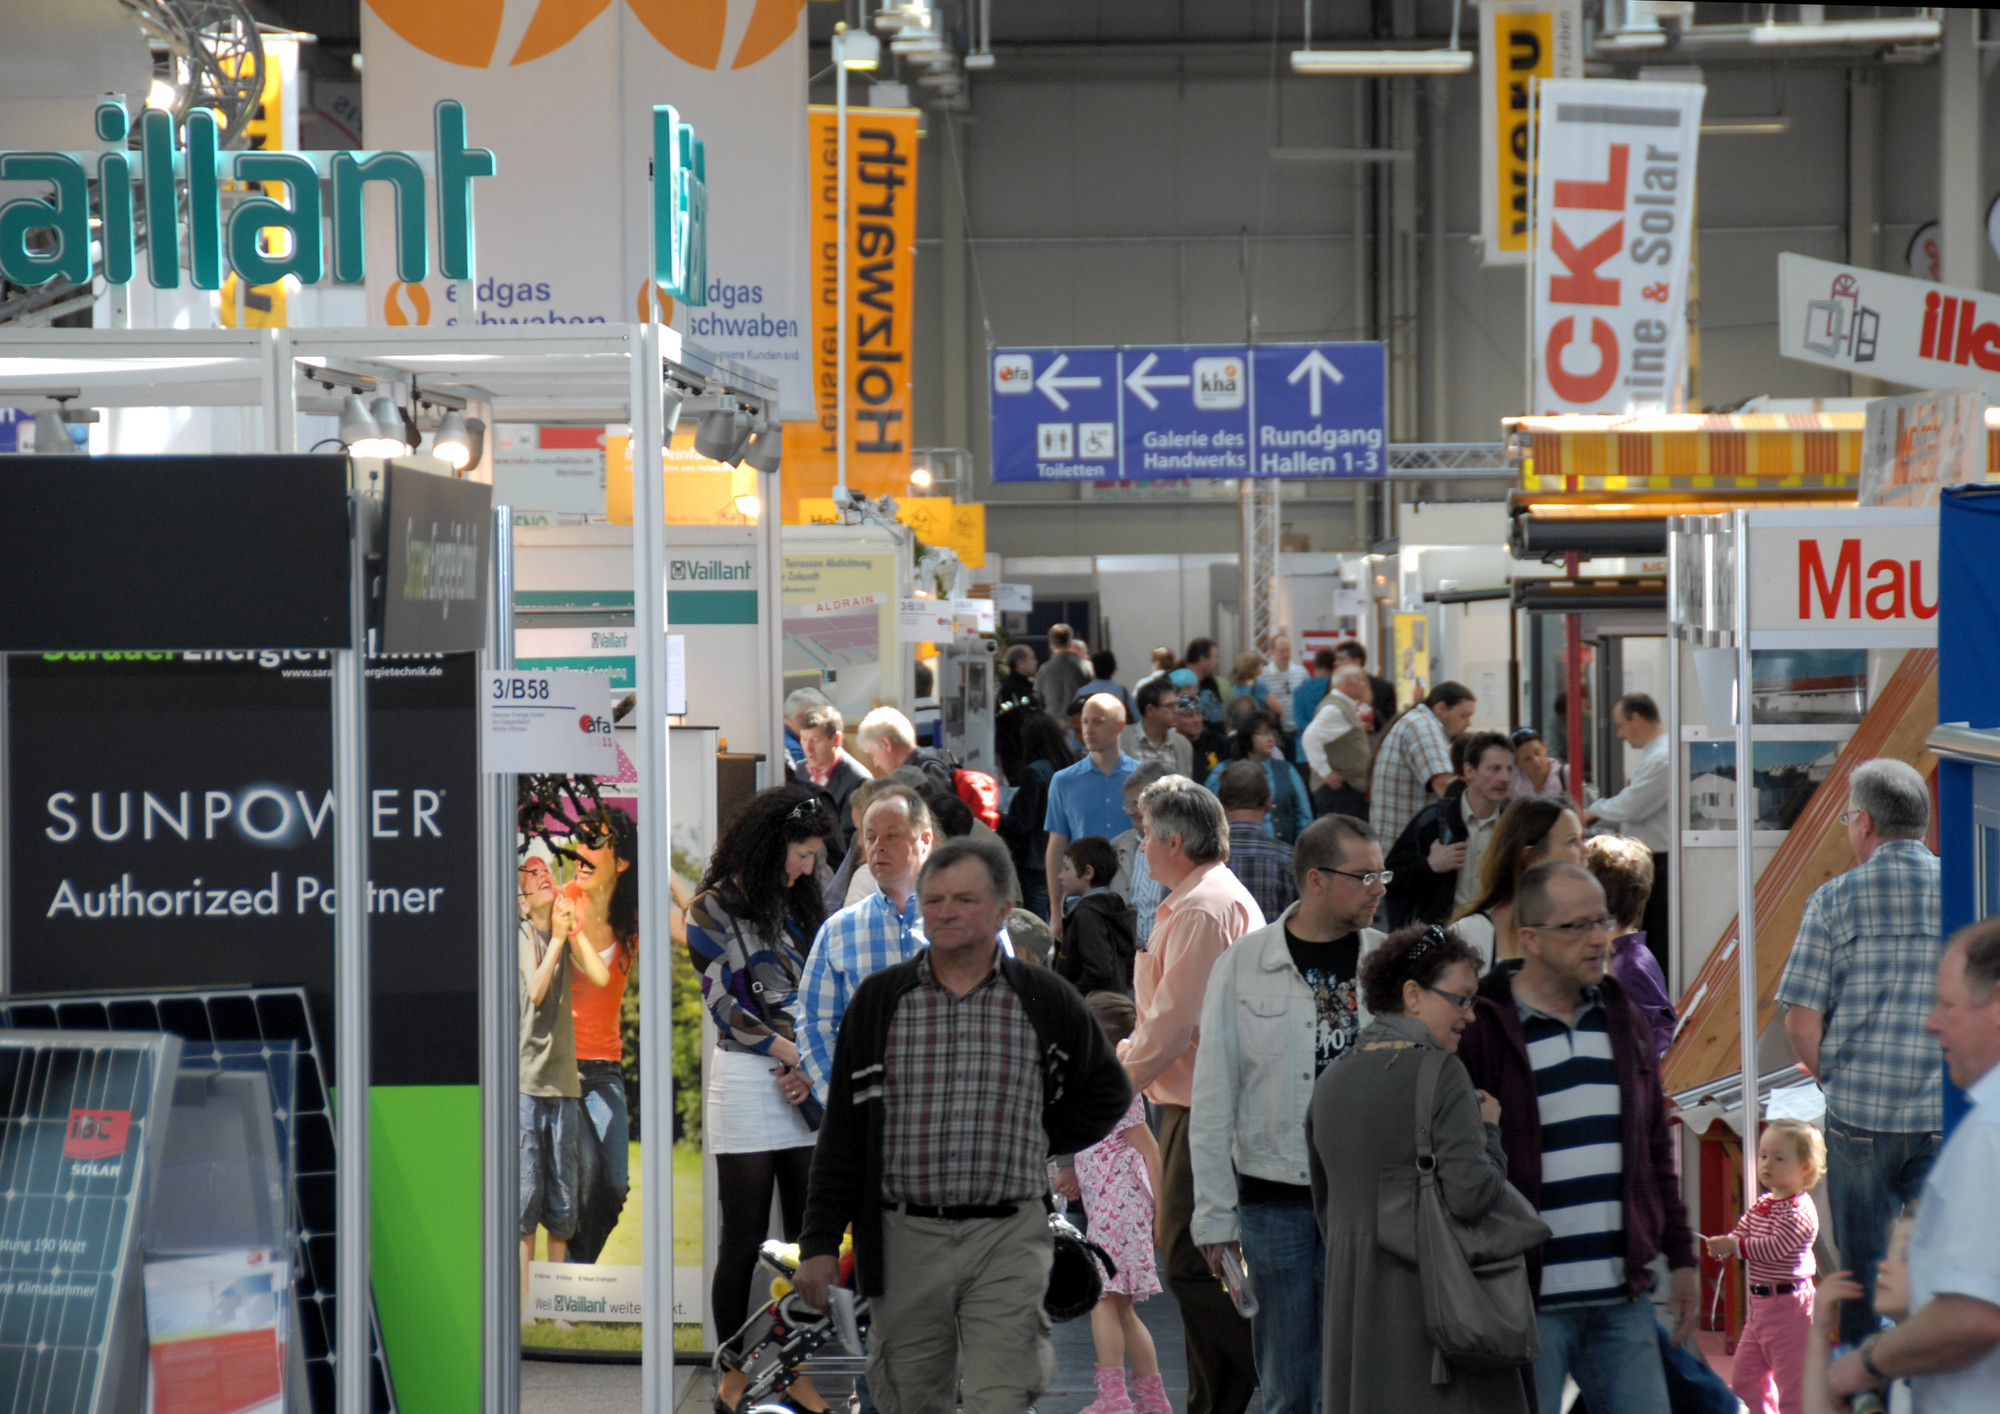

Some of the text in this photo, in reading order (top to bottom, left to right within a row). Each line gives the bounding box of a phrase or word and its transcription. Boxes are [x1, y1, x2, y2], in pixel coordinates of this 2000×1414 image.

[1630, 144, 1679, 266] Solar
[1545, 144, 1630, 415] CKL
[446, 278, 551, 307] edgas
[1640, 282, 1669, 302] &
[1143, 430, 1245, 447] Galerie des
[1260, 426, 1382, 451] Rundgang
[1144, 451, 1246, 470] Handwerks
[1261, 452, 1379, 473] Hallen 1-3
[1036, 463, 1105, 478] Toiletten
[687, 560, 752, 580] Vaillant
[826, 557, 872, 570] Abdichtung
[816, 595, 874, 612] ALDRAIN
[599, 632, 628, 648] Vaillant
[492, 678, 550, 700] 3/B58
[586, 716, 612, 734] afa
[46, 871, 279, 918] Authorized
[298, 875, 444, 914] Patner
[70, 1163, 121, 1177] SOLAR
[34, 1238, 56, 1252] 190
[58, 1239, 87, 1254] Watt
[16, 1281, 98, 1297] Klimakammer
[564, 1295, 607, 1313] Vaillant
